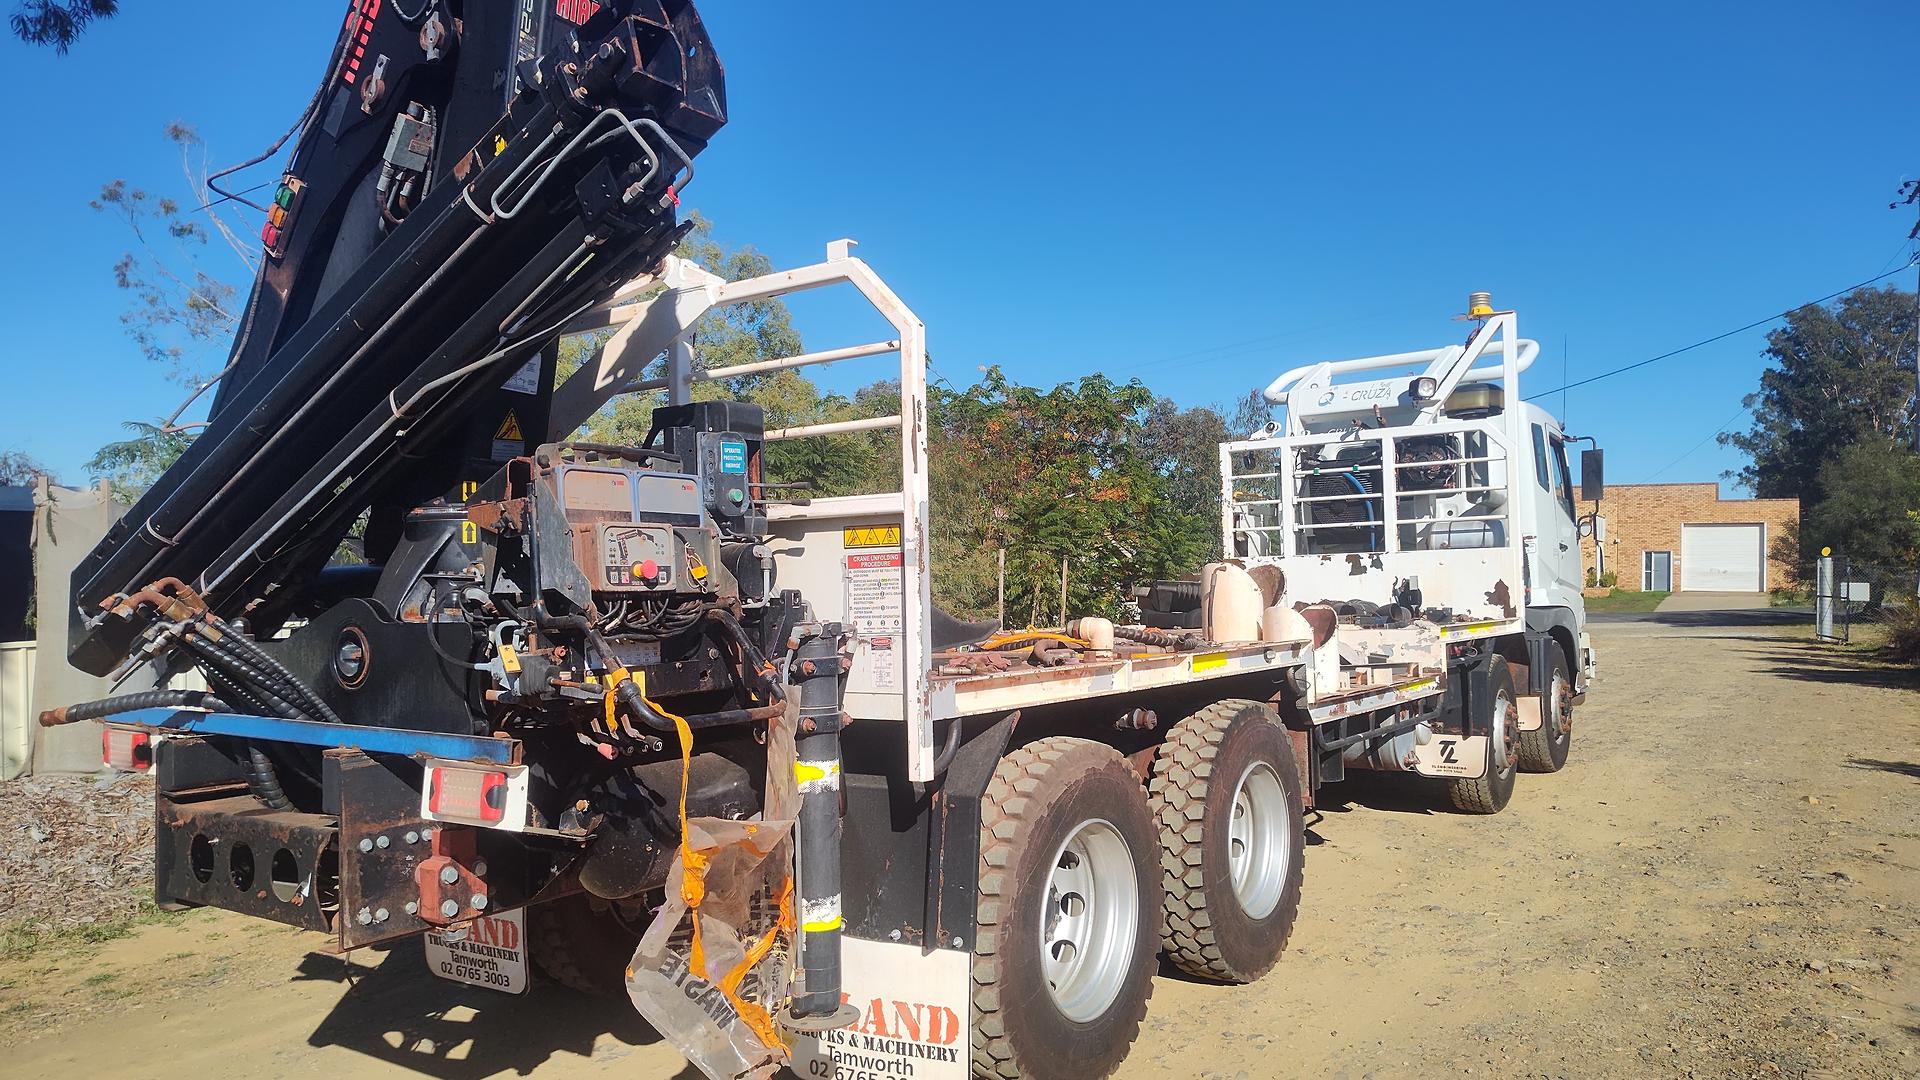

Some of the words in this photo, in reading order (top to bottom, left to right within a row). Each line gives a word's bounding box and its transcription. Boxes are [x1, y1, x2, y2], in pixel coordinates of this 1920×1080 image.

[1351, 387, 1392, 401] CRUZA
[450, 950, 499, 972] Tamworth
[468, 942, 520, 963] MACHINERY
[440, 961, 454, 975] 02
[456, 965, 481, 981] 6765
[484, 973, 510, 987] 3003
[848, 1033, 859, 1048] &
[862, 1035, 959, 1063] MACHINERY
[809, 1059, 829, 1079] 02
[826, 1044, 915, 1077] Tamworth
